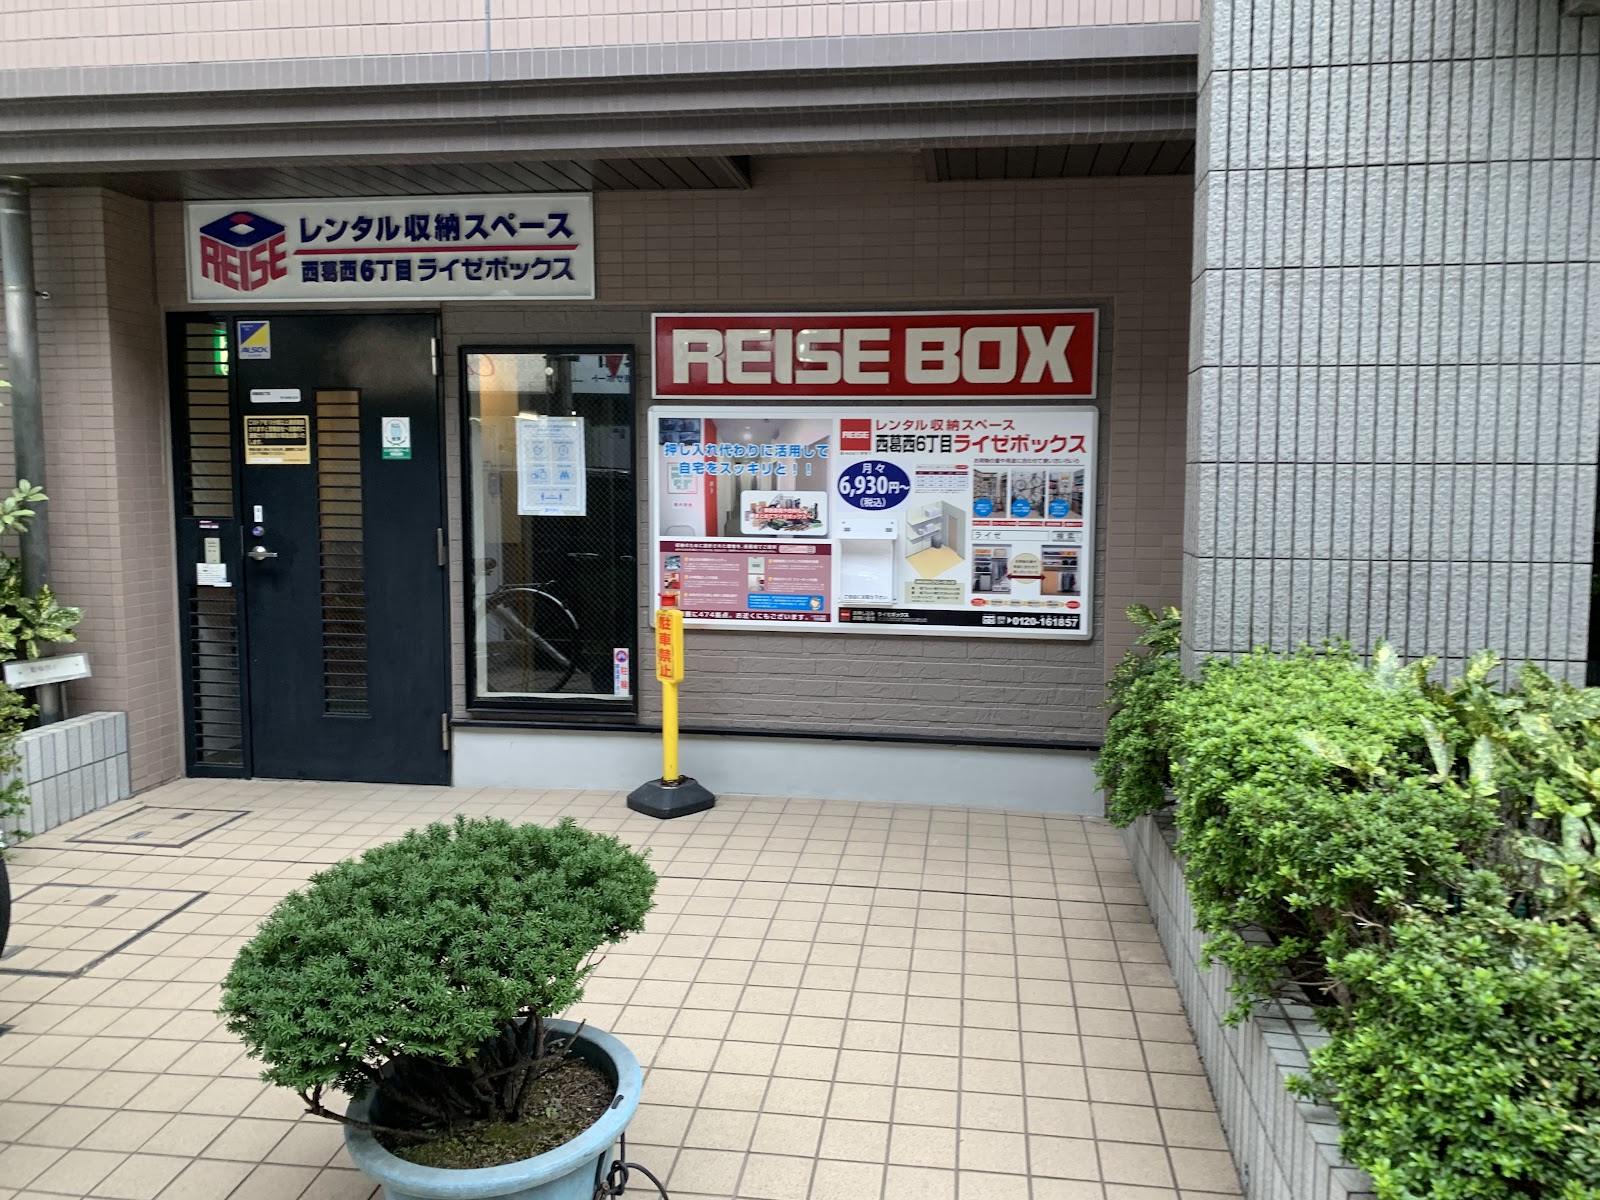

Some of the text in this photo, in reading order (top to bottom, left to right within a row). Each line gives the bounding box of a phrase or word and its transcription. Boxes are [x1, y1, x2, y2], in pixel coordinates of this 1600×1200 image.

[299, 212, 574, 243] レンタル収納スペース
[200, 234, 288, 292] REISE
[301, 256, 575, 284] 西葛西6丁目ライゼボックス
[672, 325, 1076, 384] REISE BOX
[875, 419, 1016, 432] レンタル収納スペース
[664, 443, 829, 458] 押し入れ代わりに活用して
[679, 462, 812, 475] 自宅をスッキリと！！
[861, 463, 886, 473] 月々
[975, 531, 1001, 539] ライゼ
[1012, 616, 1078, 627] 0120-161857
[658, 616, 673, 679] 駐車禁止
